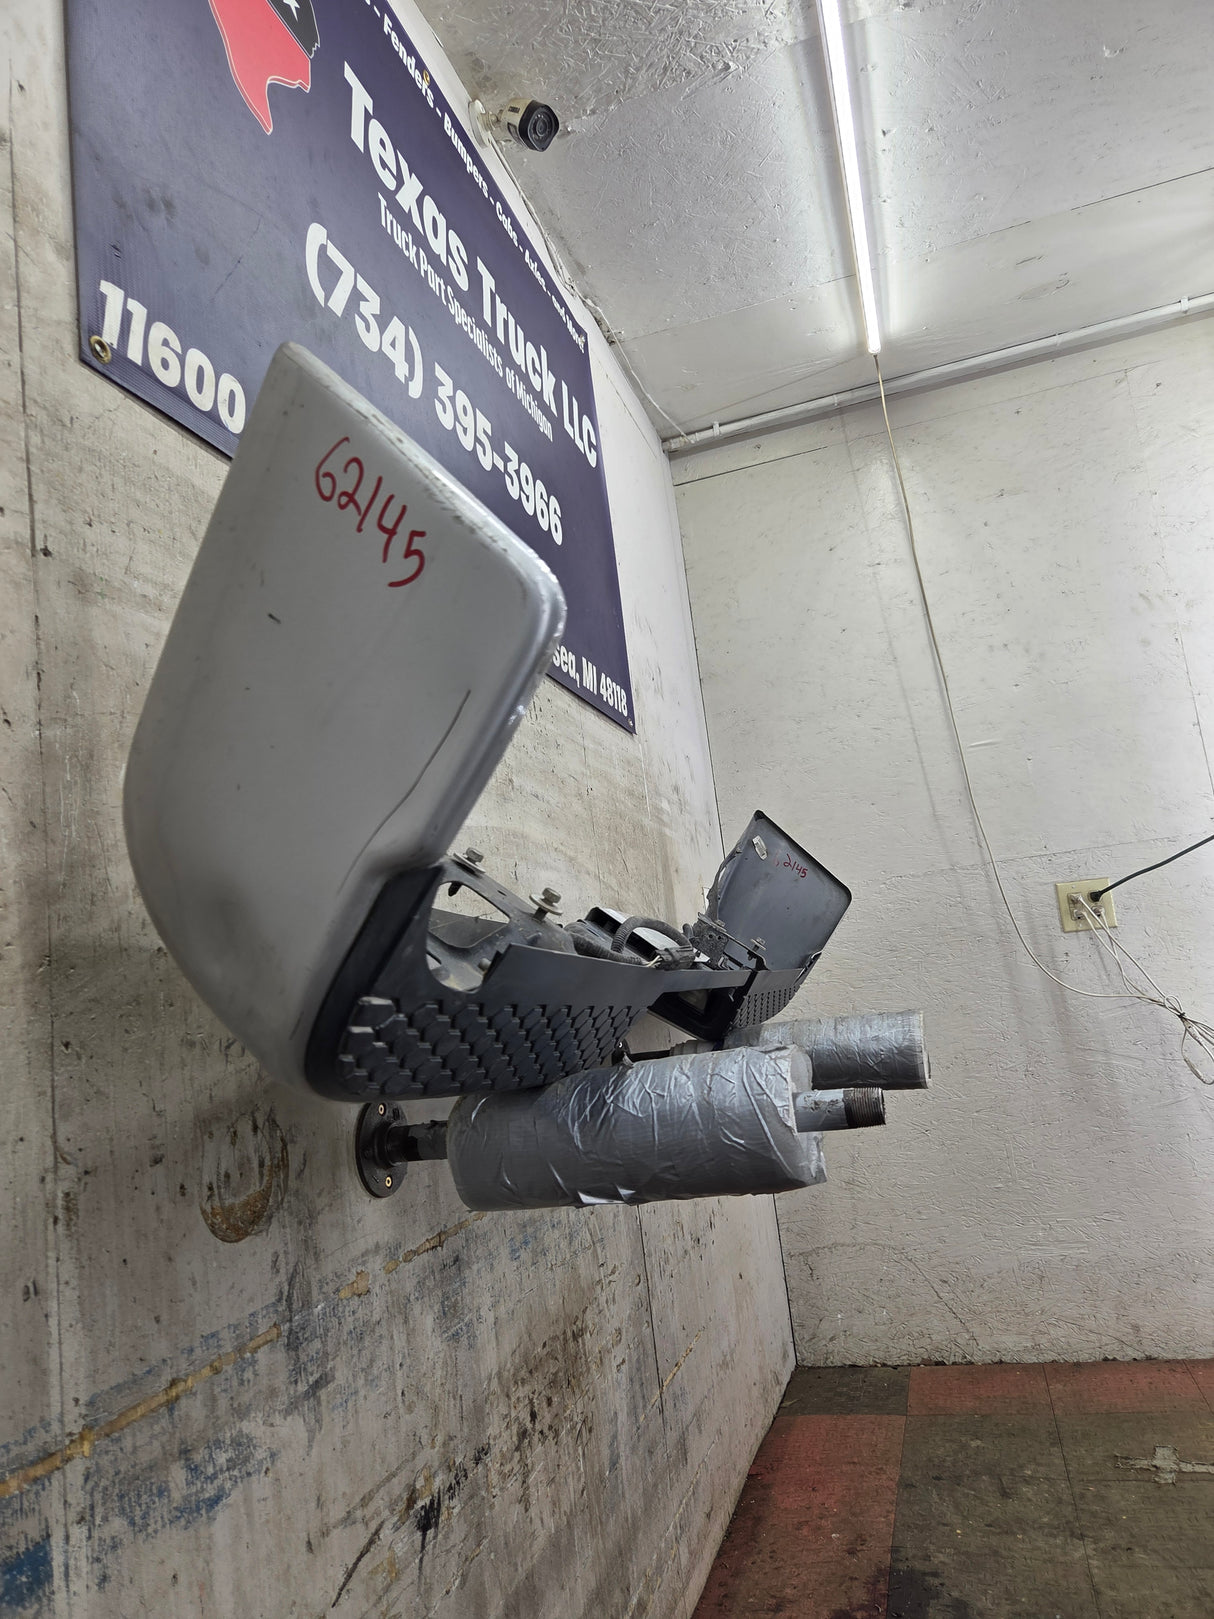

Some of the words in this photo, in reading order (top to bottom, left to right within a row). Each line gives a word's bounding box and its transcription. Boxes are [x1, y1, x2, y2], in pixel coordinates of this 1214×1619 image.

[343, 60, 469, 292] Texas
[477, 256, 558, 418] Truck
[562, 379, 597, 469] LLC
[383, 13, 435, 109] Fenders
[444, 112, 489, 198] Bumpers
[496, 201, 519, 247] Cabs
[305, 222, 423, 399] (734)
[434, 361, 563, 546] 395-3966
[378, 191, 419, 270] Truck
[419, 247, 447, 306] Part
[447, 285, 503, 378] Specialists
[506, 366, 517, 393] of
[516, 381, 553, 443] Michigan
[99, 279, 246, 435] 11600
[582, 656, 598, 696] MI
[600, 672, 628, 717] 48118
[315, 436, 427, 588] 62145
